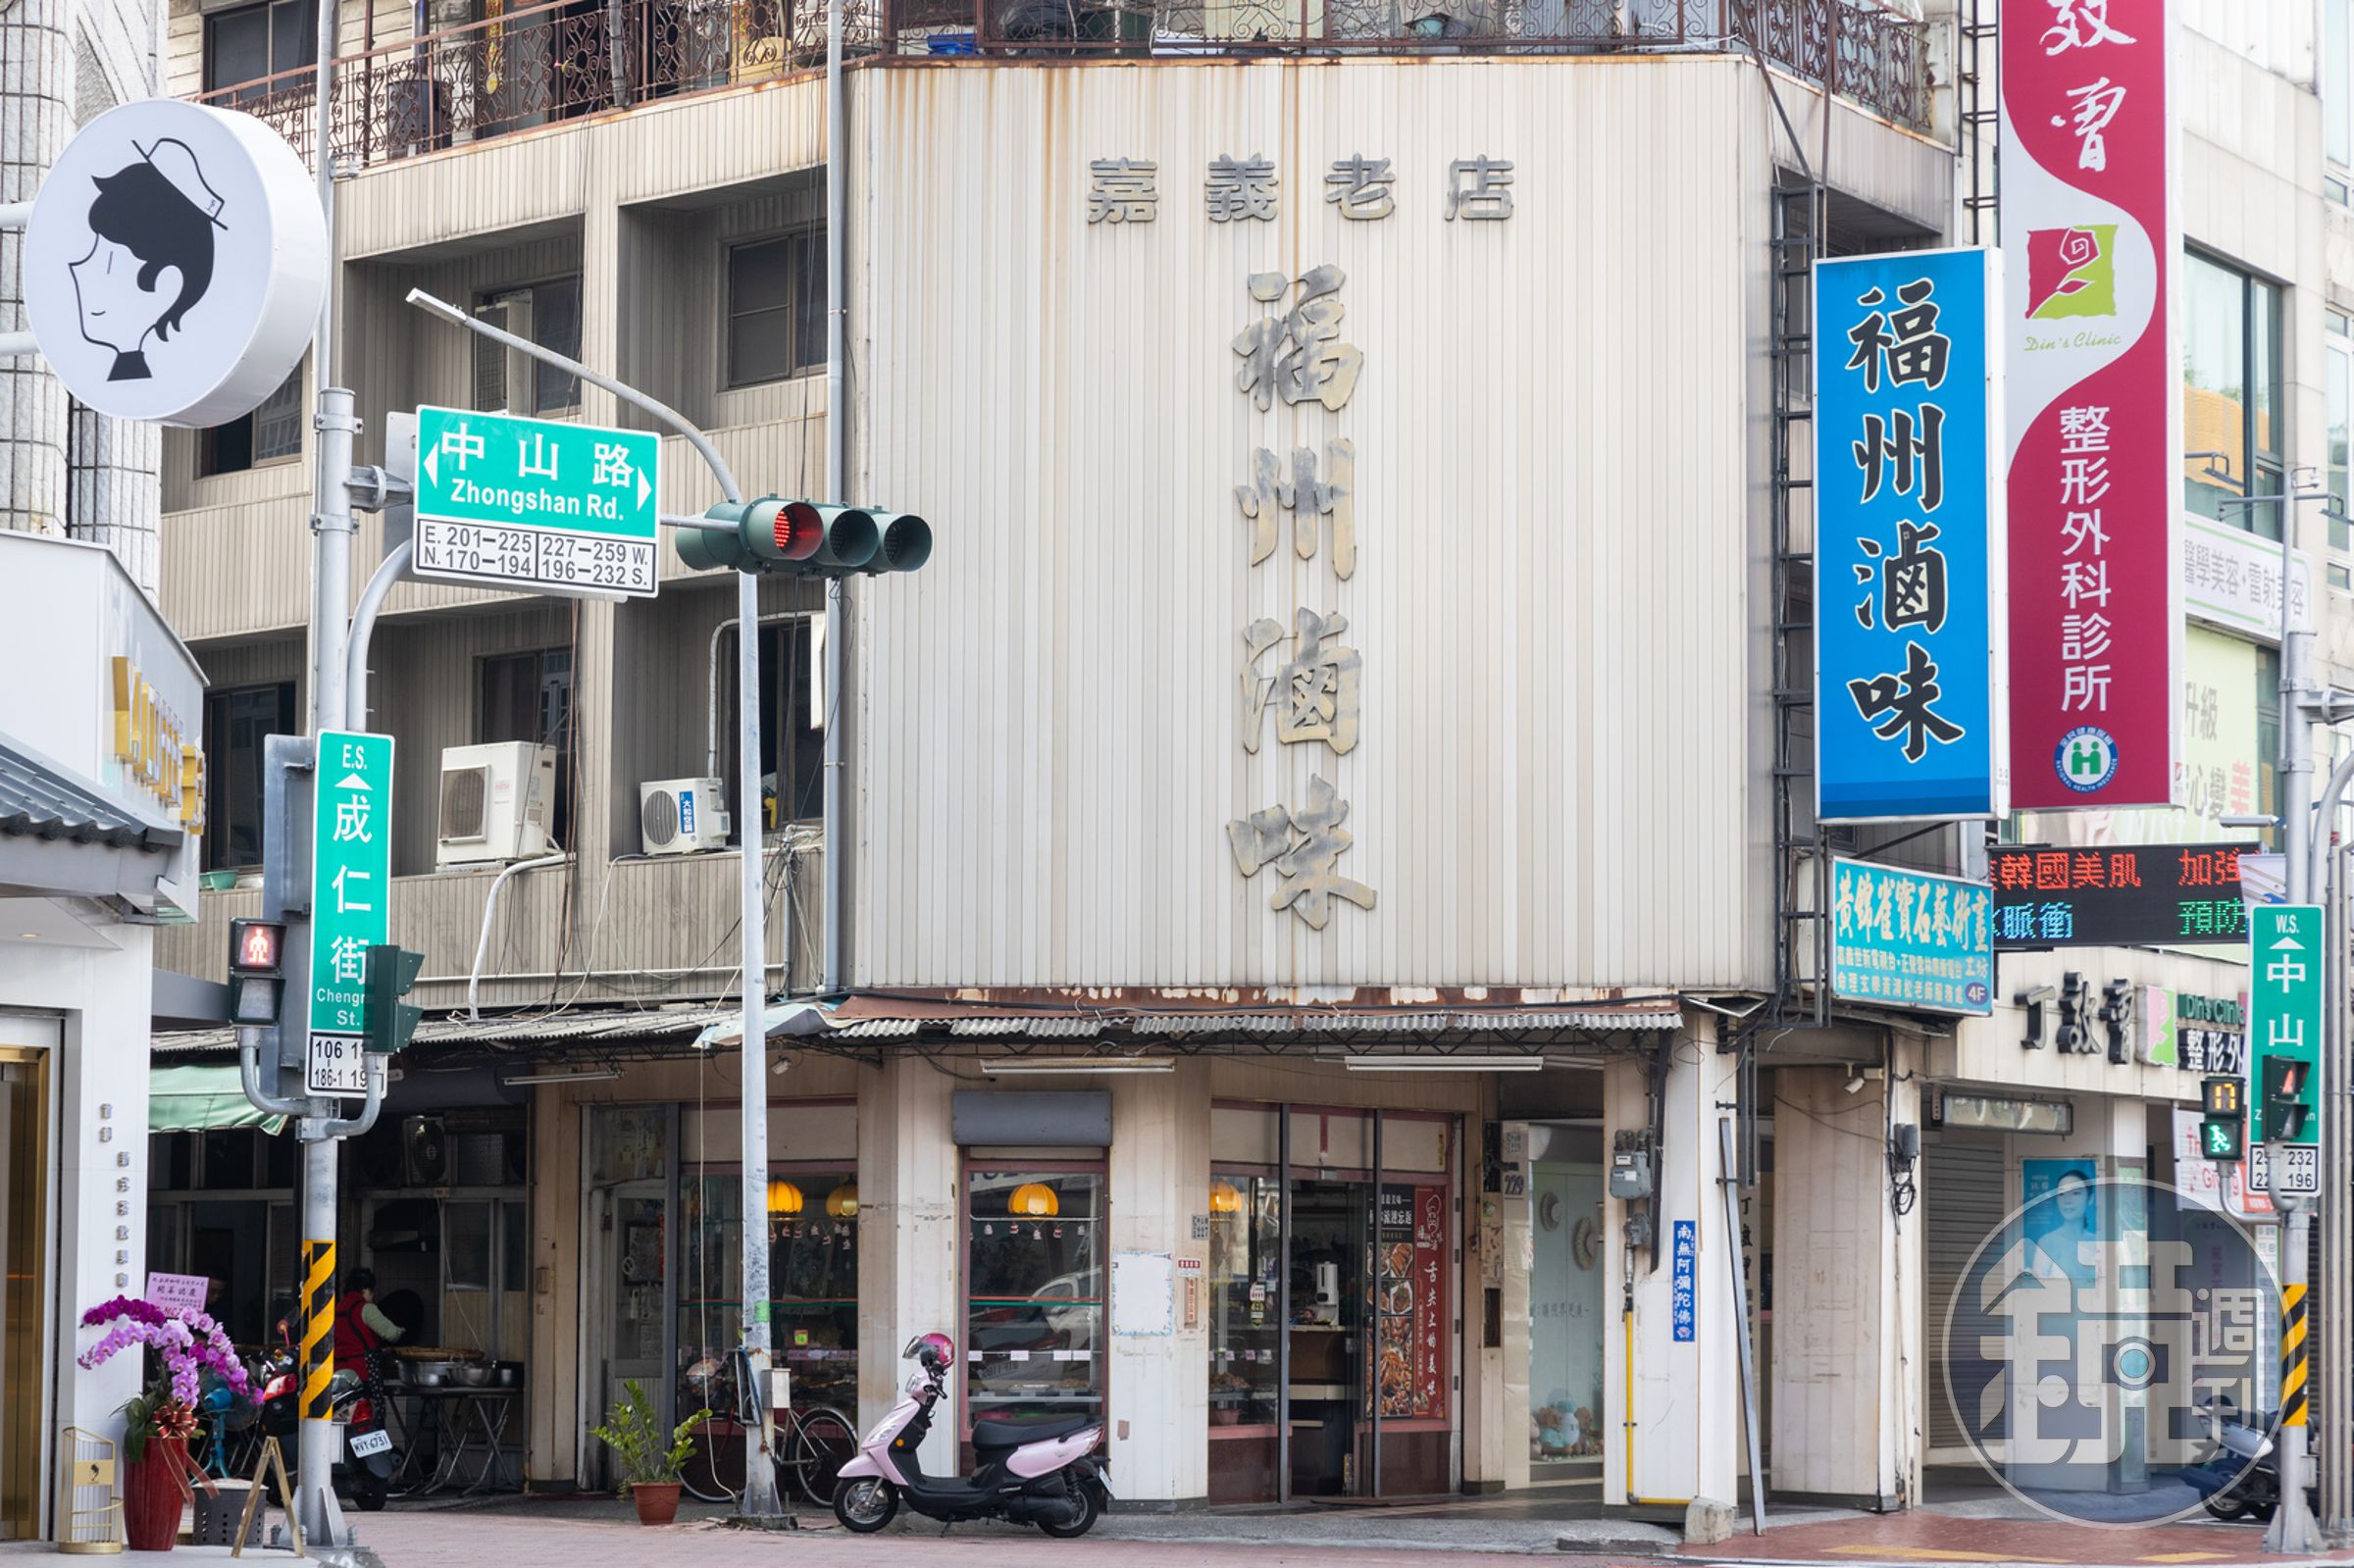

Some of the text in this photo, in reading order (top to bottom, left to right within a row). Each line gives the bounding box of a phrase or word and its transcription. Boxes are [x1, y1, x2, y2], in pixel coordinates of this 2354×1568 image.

[1087, 152, 1516, 225] 嘉義老店
[2073, 331, 2122, 349] Clinic
[441, 423, 636, 488] 中山路
[450, 478, 624, 521] Zhongshan Rd.
[1845, 277, 1967, 764] 福州滷味
[425, 525, 441, 544] E.
[424, 546, 440, 566] N.
[633, 547, 647, 566] W.
[2059, 405, 2113, 713] 整形外科診所
[631, 568, 647, 586] S.
[1226, 263, 1378, 932] 福州滷味
[342, 743, 368, 770] E.S.
[330, 793, 373, 986] 成仁街
[2276, 914, 2300, 934] W.S.
[1968, 985, 1986, 1002] 4F
[336, 1010, 360, 1027] St.
[315, 1040, 343, 1059] 106
[2288, 1150, 2314, 1166] 232
[2288, 1173, 2313, 1188] 196
[1676, 1224, 1692, 1325] 南無阿彌陀佛
